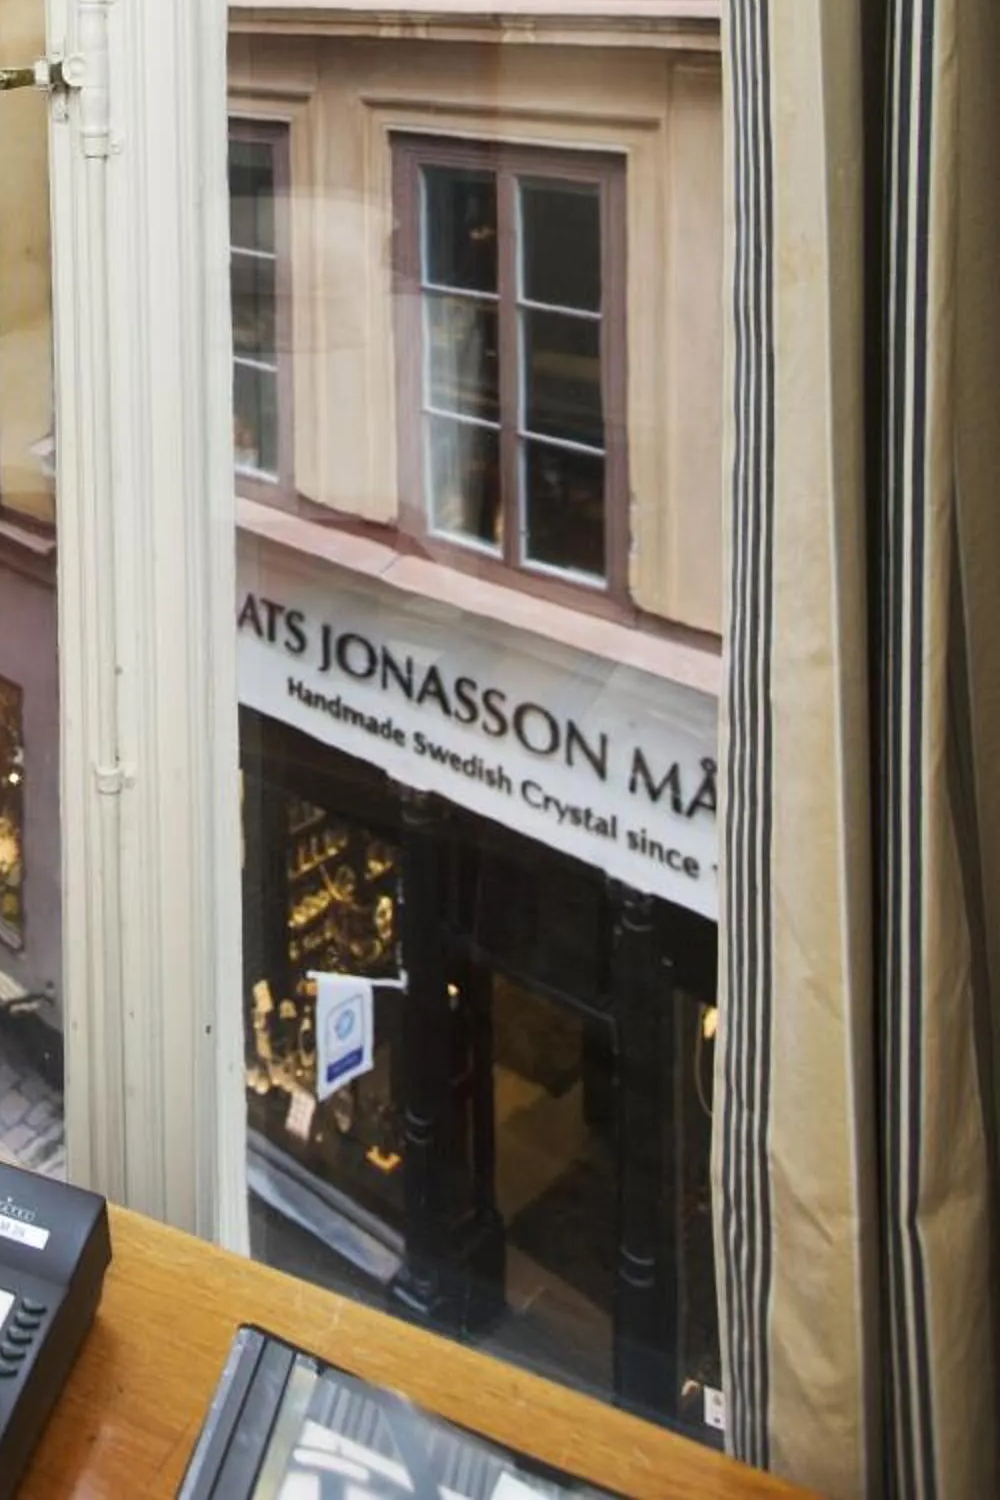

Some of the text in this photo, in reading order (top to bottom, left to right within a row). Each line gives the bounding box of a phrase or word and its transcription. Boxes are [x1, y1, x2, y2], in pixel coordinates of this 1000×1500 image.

[287, 675, 701, 880] Handmade Swedish Crystal since
[318, 622, 608, 782] JONASSON
